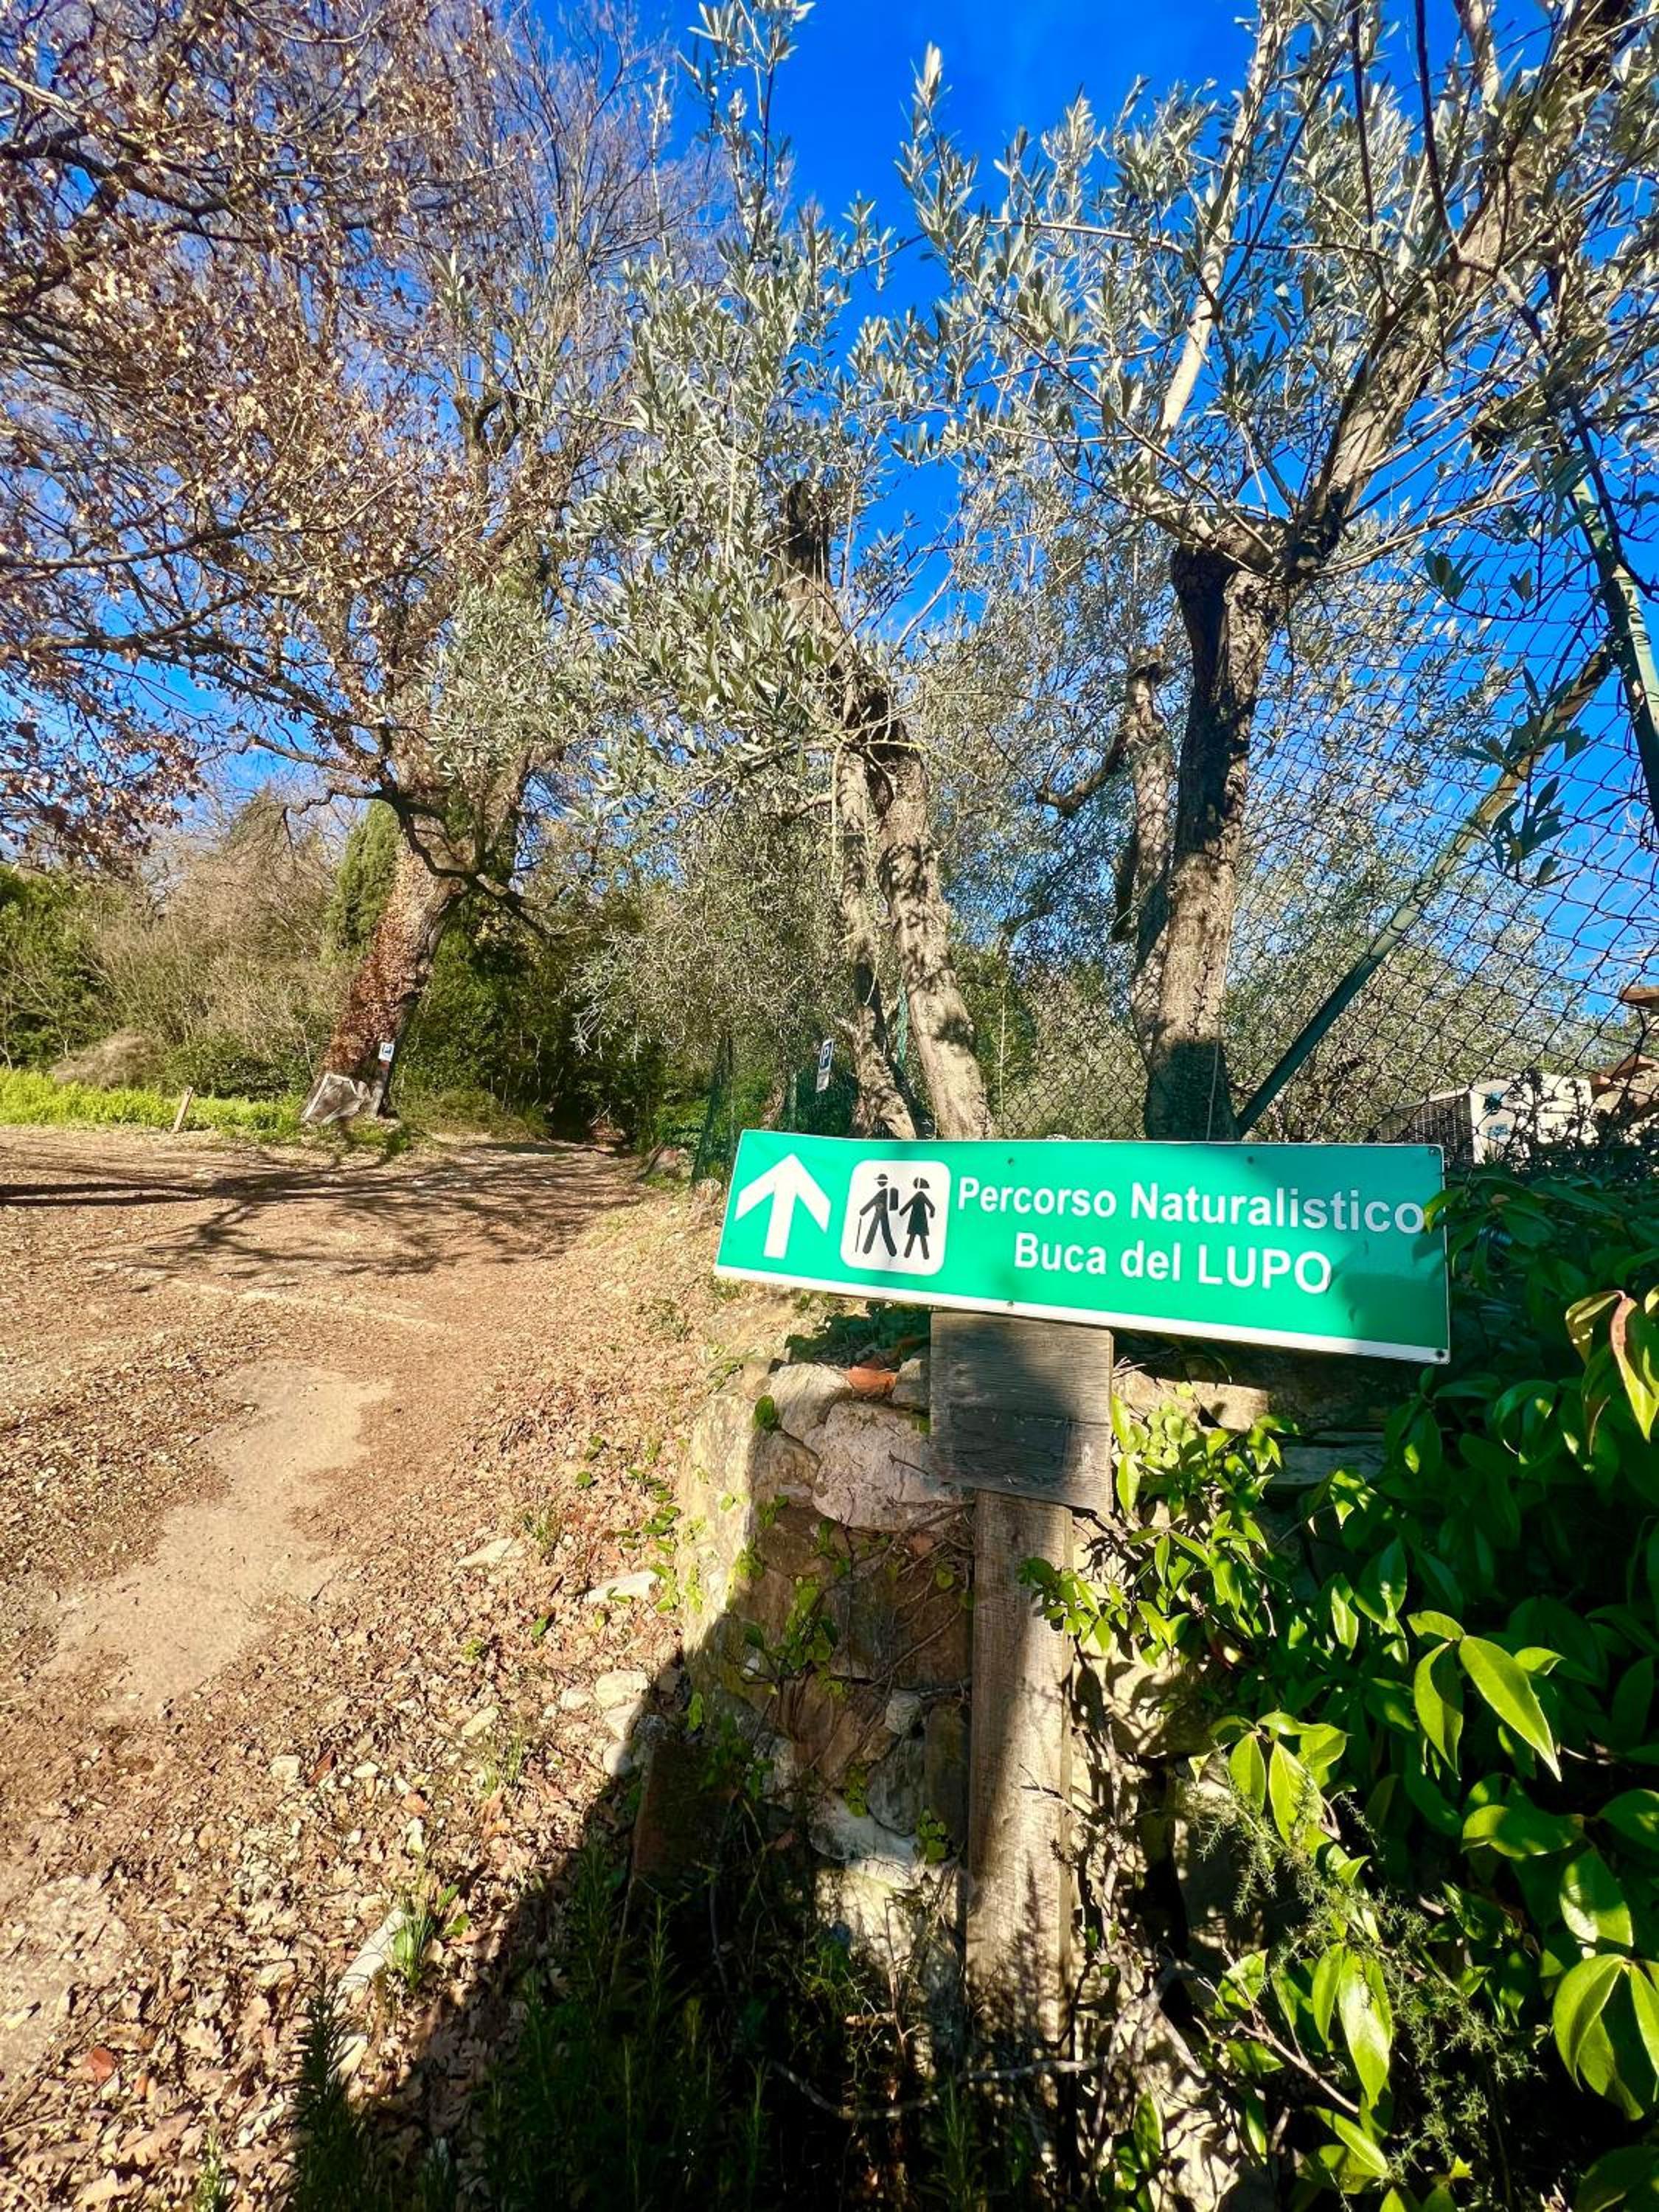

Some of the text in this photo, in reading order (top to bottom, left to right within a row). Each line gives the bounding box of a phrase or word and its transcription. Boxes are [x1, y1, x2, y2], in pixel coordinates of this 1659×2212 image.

[821, 1045, 830, 1066] P
[959, 1177, 1425, 1234] Percorso Naturalistico
[1014, 1232, 1332, 1294] Buca del LUPO
